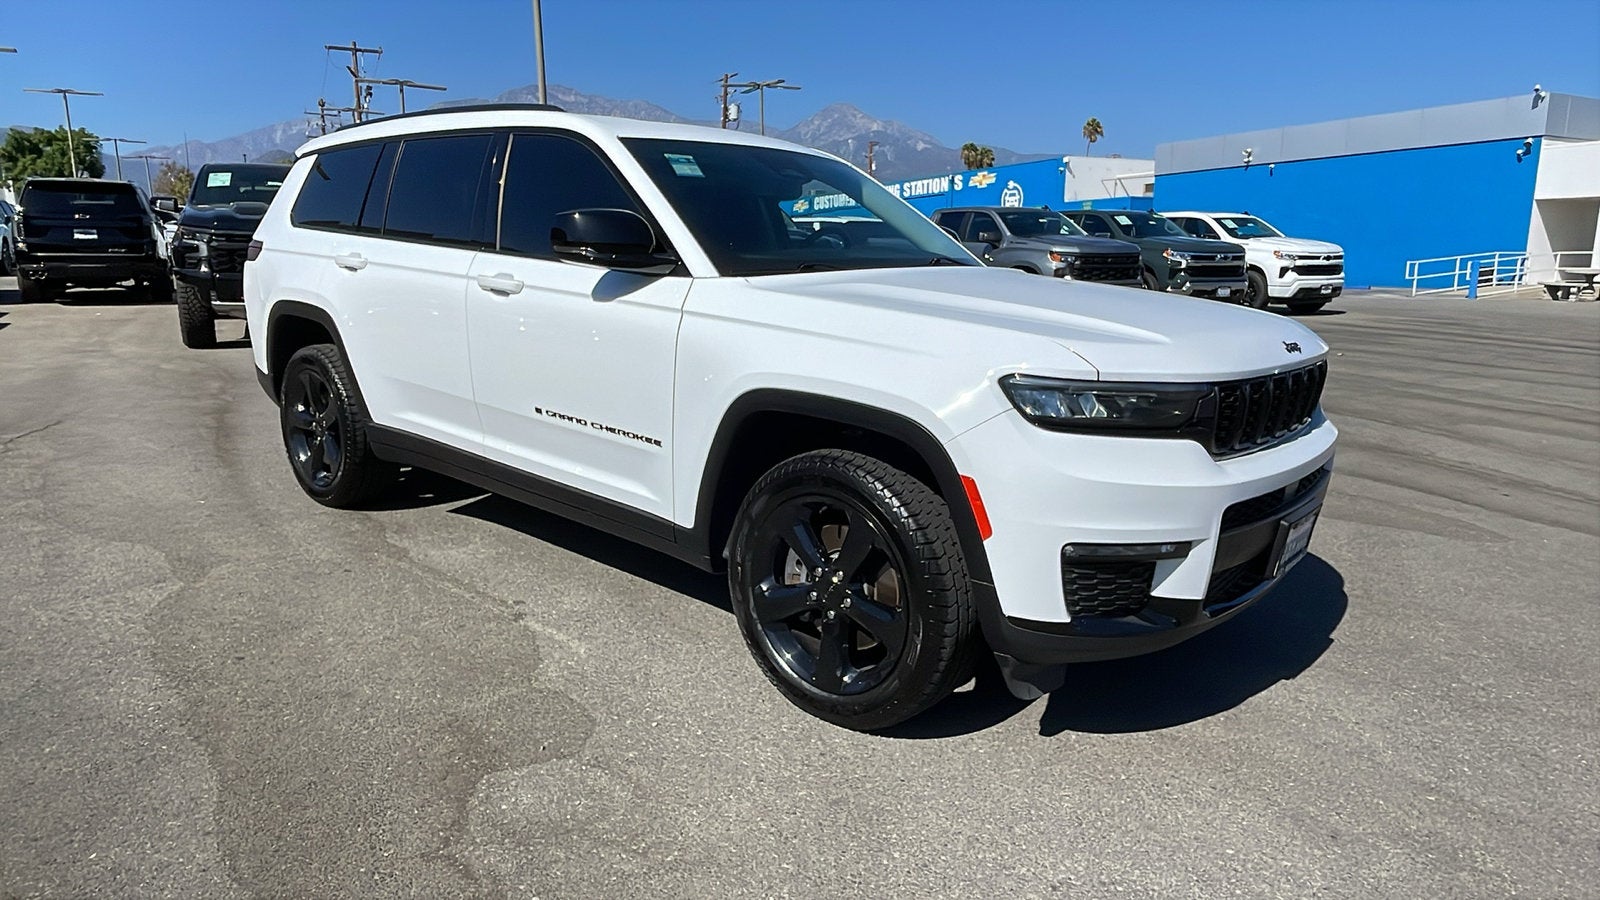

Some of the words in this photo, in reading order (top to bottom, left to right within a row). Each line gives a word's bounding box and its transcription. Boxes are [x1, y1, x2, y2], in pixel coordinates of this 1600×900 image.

[903, 174, 963, 197] STATION'S
[545, 409, 588, 426] GRAND
[591, 422, 662, 447] CHEROKEE
